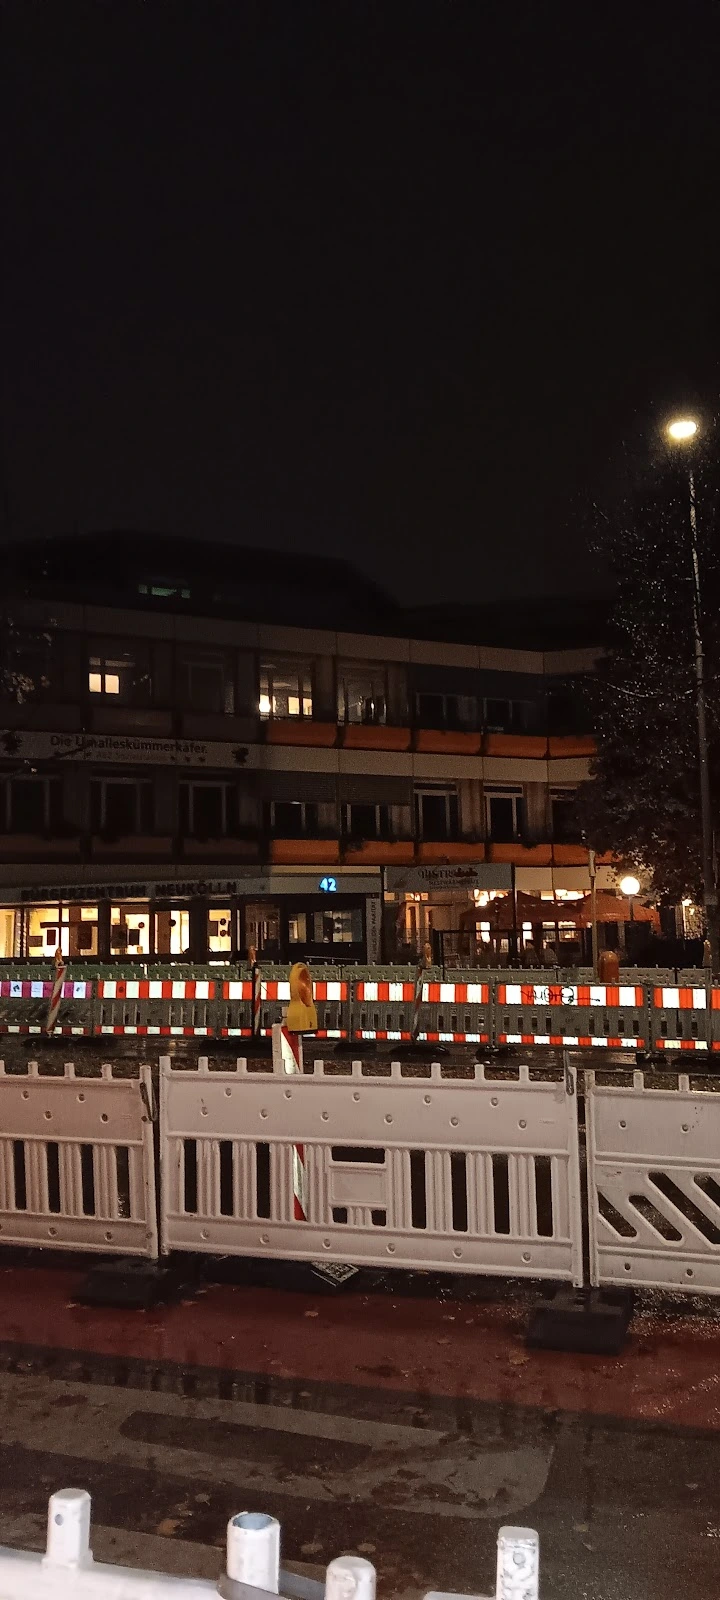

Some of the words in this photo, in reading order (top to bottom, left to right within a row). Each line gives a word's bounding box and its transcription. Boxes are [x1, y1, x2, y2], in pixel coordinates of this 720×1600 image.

[51, 734, 72, 747] Die
[20, 884, 146, 901] BÜRGERZENTRUM
[155, 880, 237, 896] NEUKÖLLN
[319, 877, 337, 892] 42
